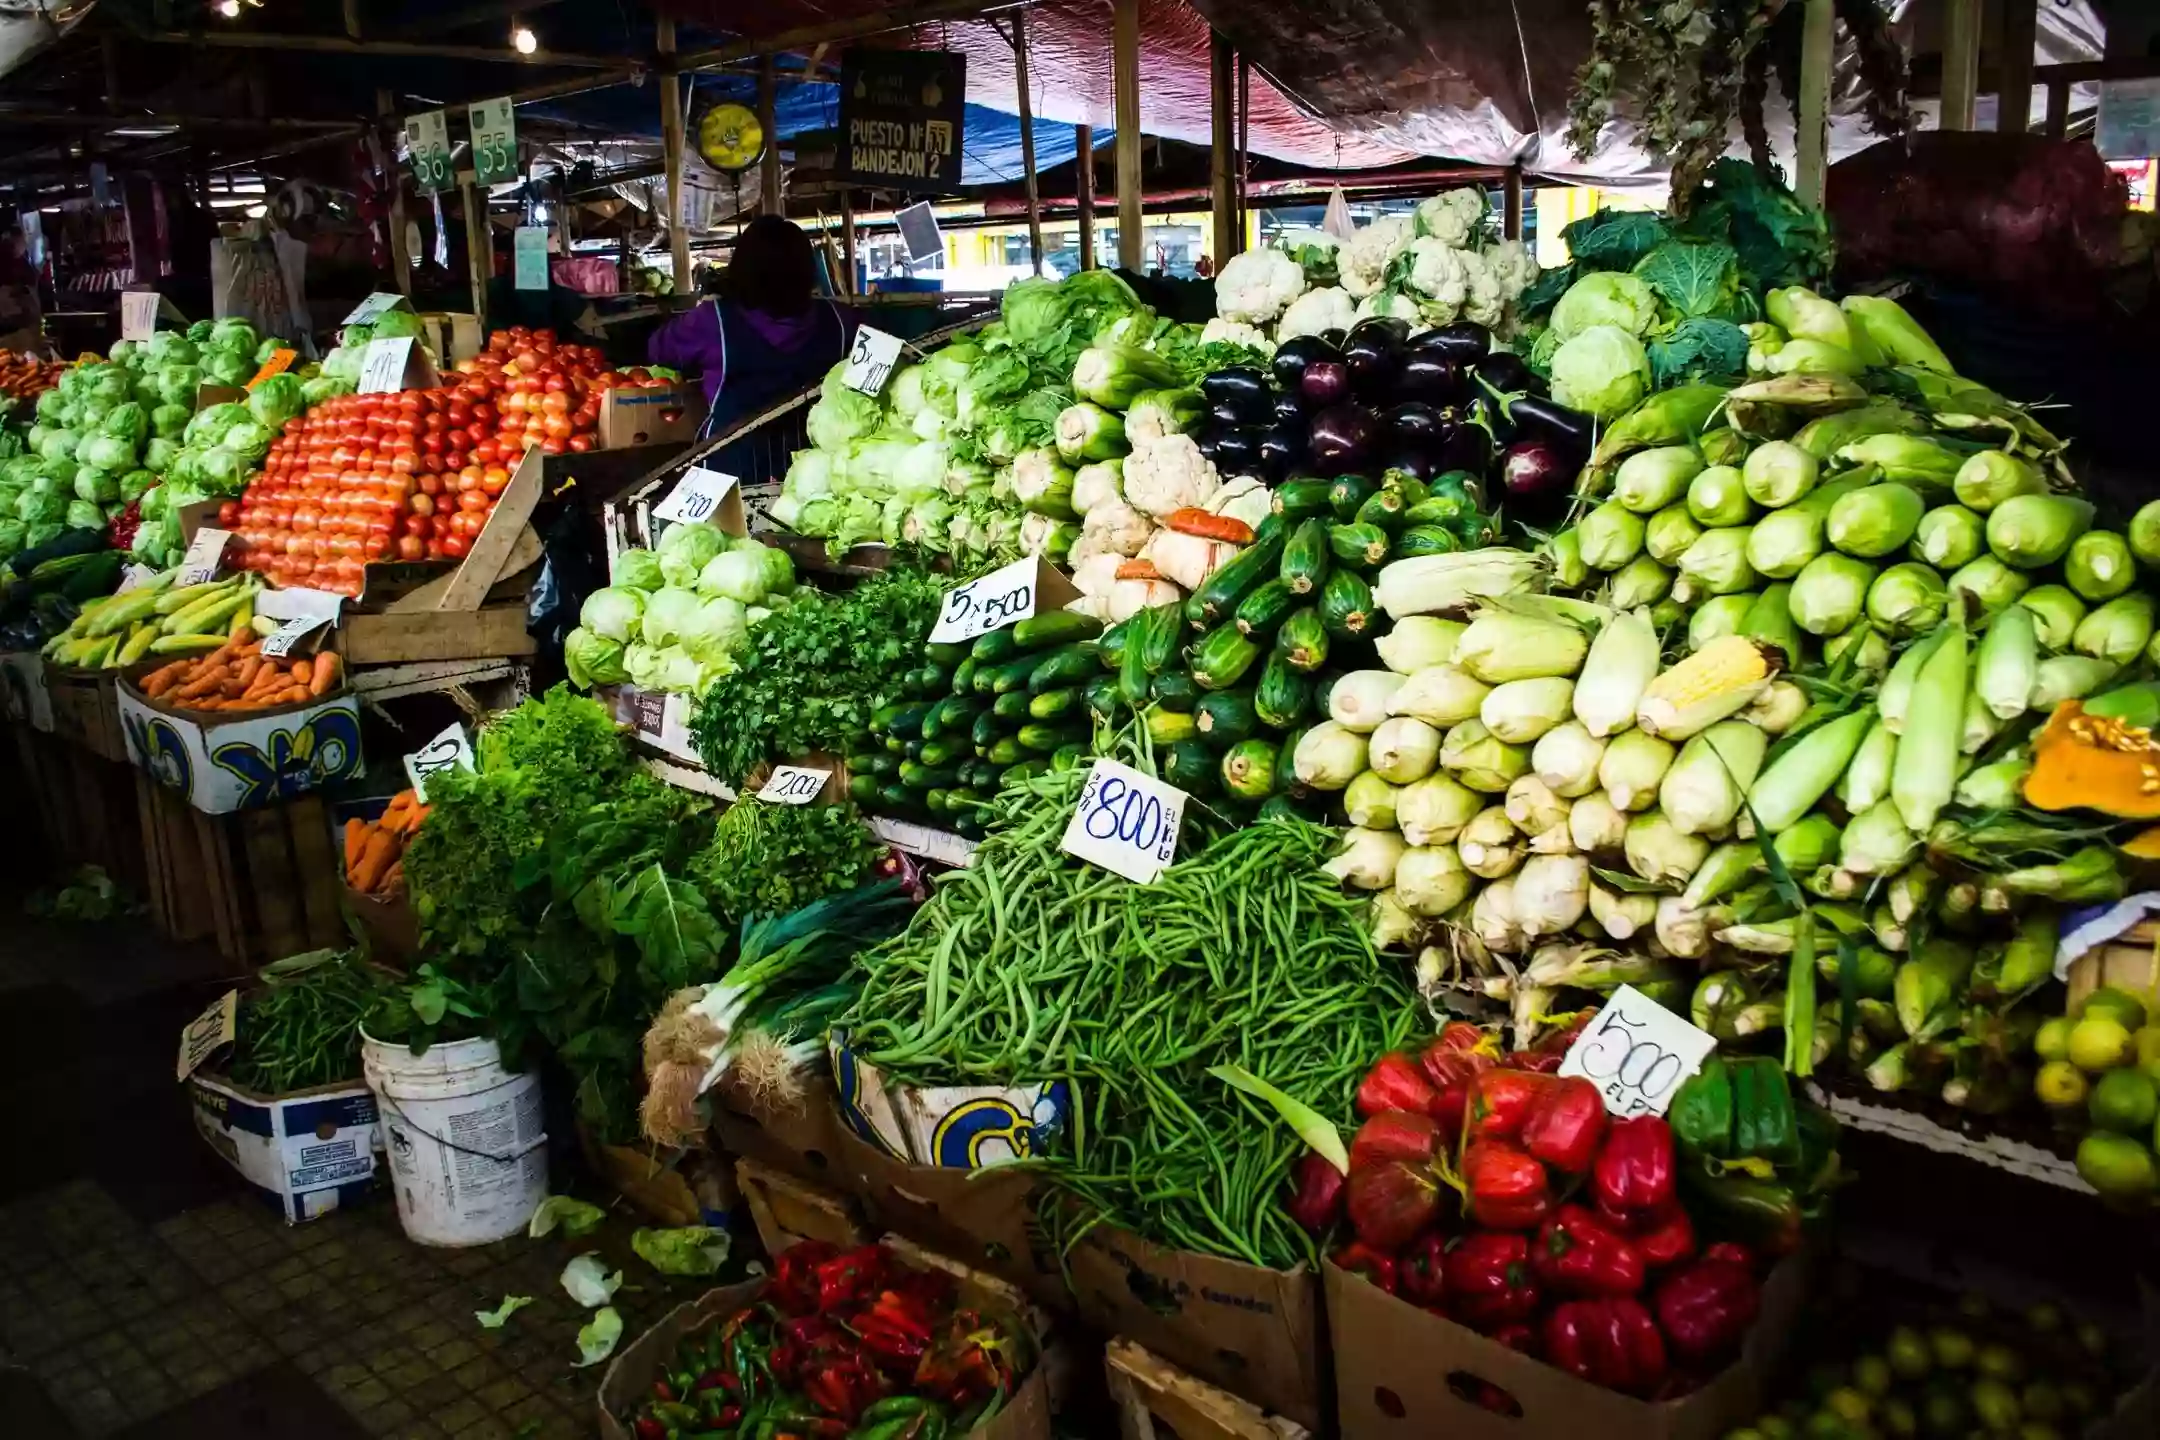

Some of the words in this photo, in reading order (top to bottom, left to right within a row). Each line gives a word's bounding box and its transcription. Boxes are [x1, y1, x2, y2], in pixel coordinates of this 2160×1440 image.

[850, 118, 904, 147] PUESTO
[416, 141, 444, 184] 56
[480, 132, 507, 174] 55
[851, 145, 926, 179] BANDEJON
[929, 154, 941, 179] 2
[852, 329, 872, 367] 3
[945, 581, 978, 624] 5
[982, 585, 1031, 629] 500
[775, 770, 817, 797] 200
[1085, 777, 1161, 851] 800
[1164, 807, 1176, 823] EL
[1581, 1009, 1682, 1099] 500
[1606, 1081, 1625, 1103] EL
